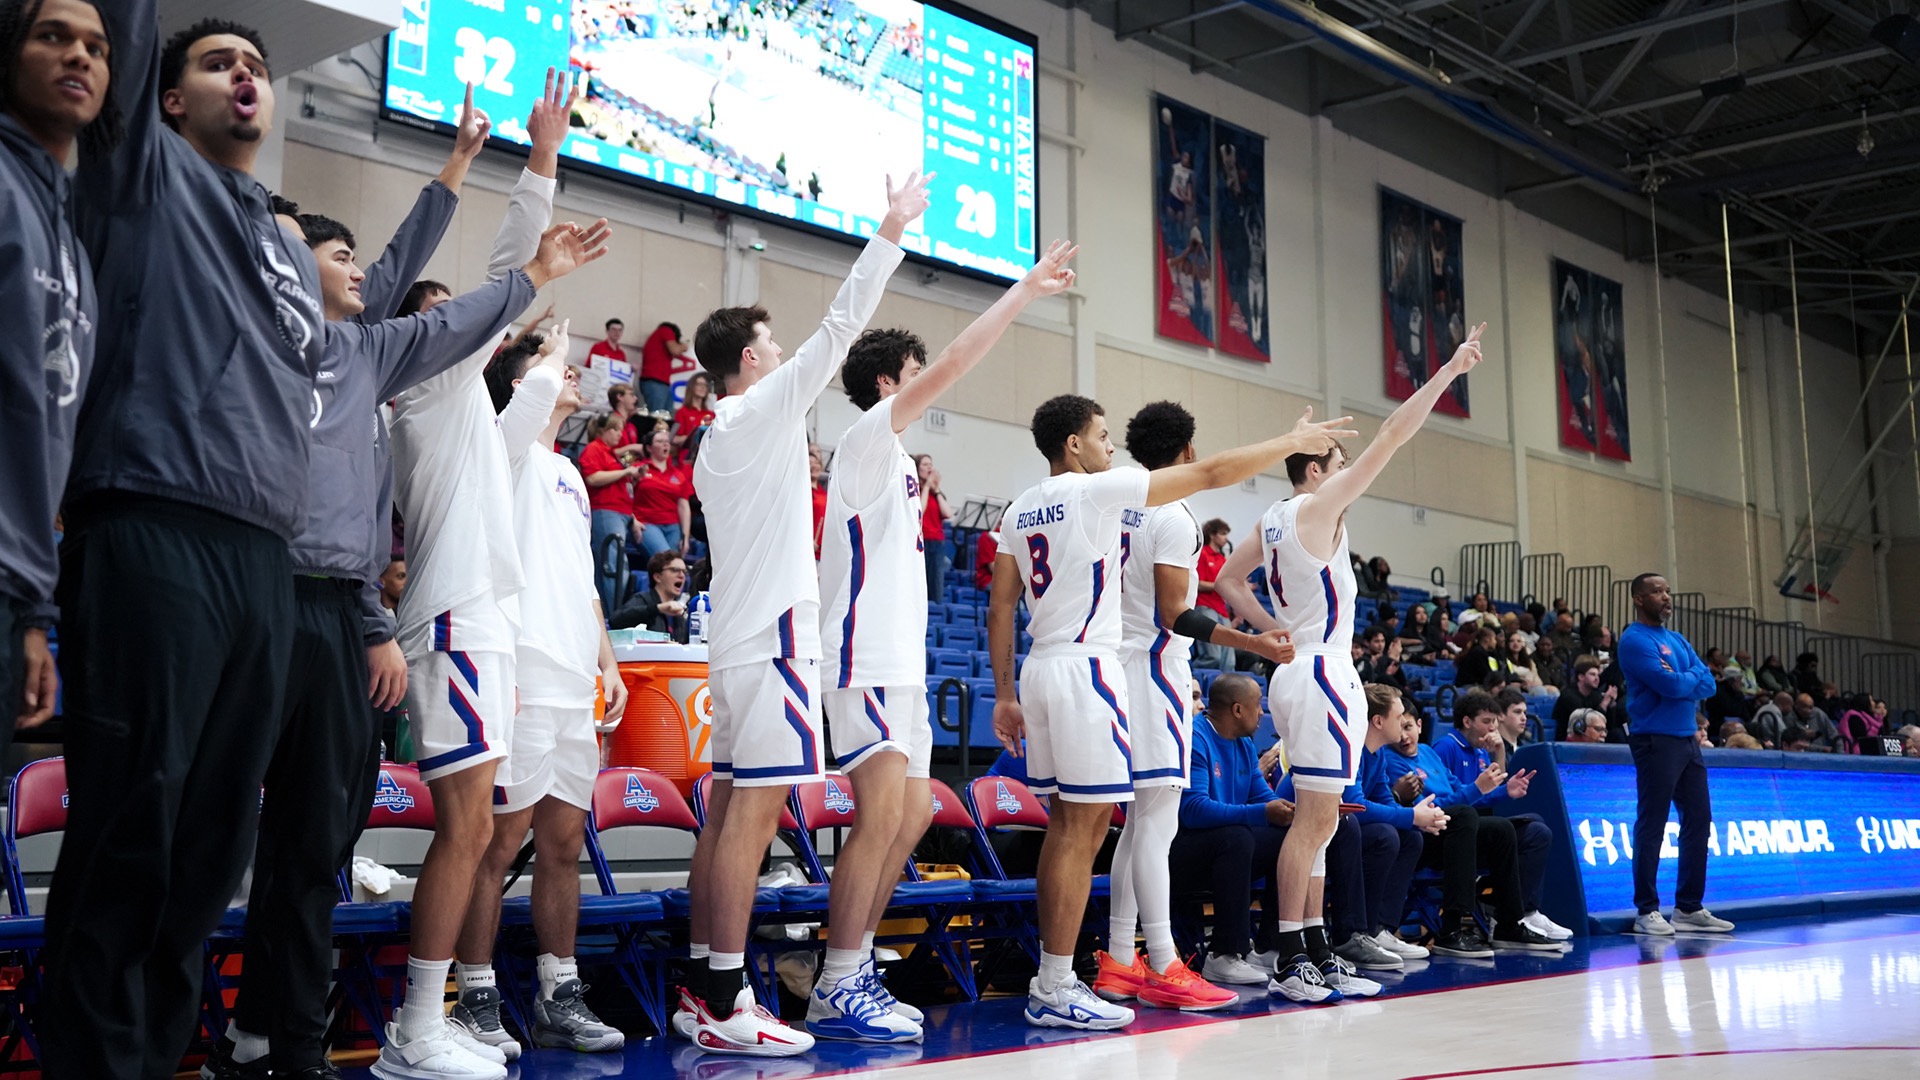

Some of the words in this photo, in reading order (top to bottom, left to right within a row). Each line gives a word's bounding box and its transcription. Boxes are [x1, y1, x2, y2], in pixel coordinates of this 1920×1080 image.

[455, 27, 516, 96] 32
[1016, 503, 1065, 530] HOGANS
[1026, 532, 1053, 600] 3
[1883, 738, 1903, 753] POSS
[373, 796, 413, 805] AMERICAN
[625, 798, 658, 806] AMERICAN
[825, 800, 854, 808] AMERICAN
